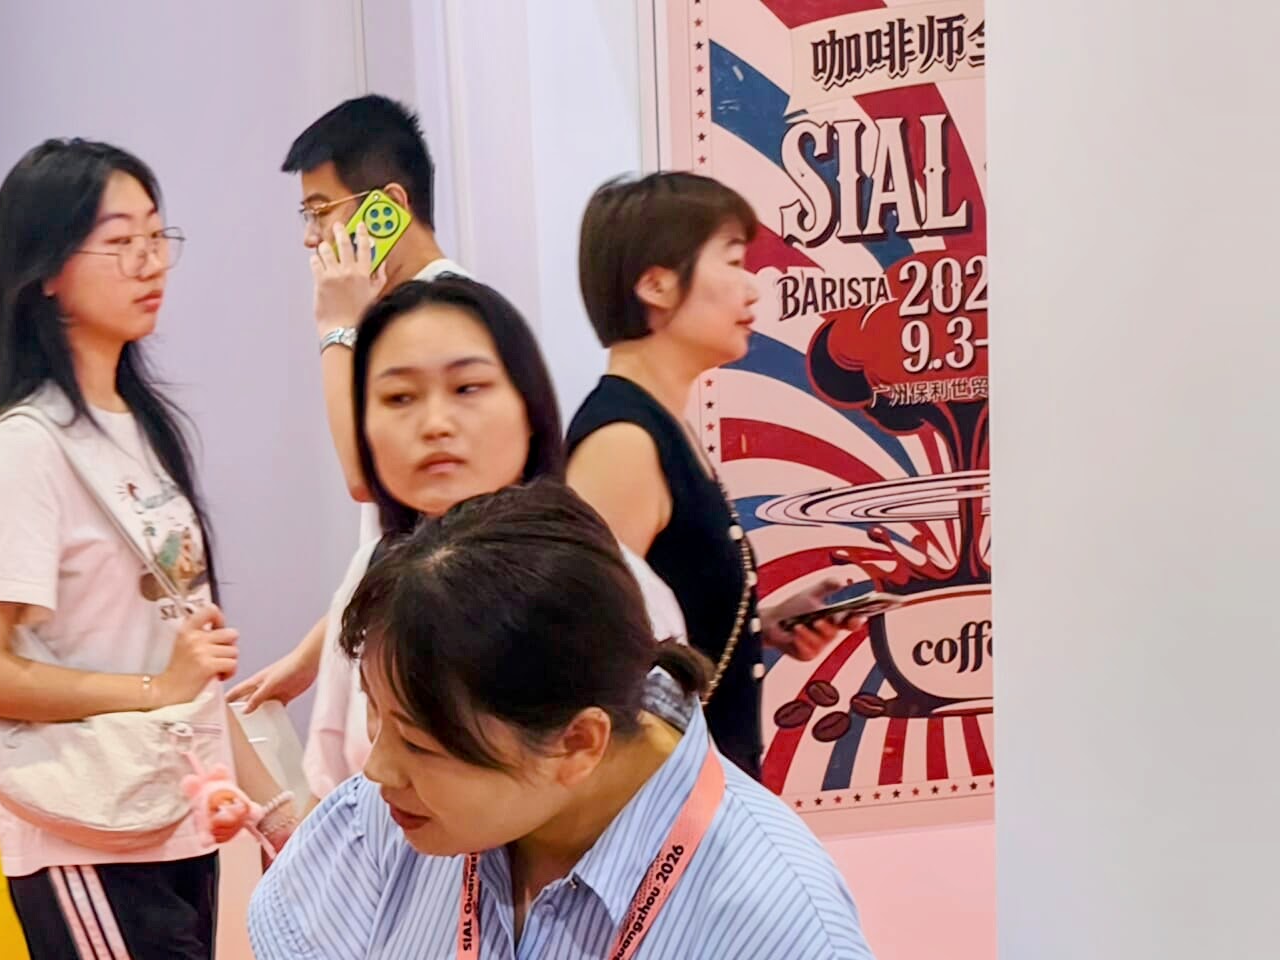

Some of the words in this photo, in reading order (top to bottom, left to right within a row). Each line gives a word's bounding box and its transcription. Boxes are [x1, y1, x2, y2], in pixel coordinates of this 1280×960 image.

[780, 113, 972, 248] SIAL
[778, 271, 890, 321] BARISTA
[871, 376, 988, 408] 广州保利世贸
[912, 620, 992, 674] coff
[635, 844, 685, 885] 2026
[463, 922, 473, 952] SIAL
